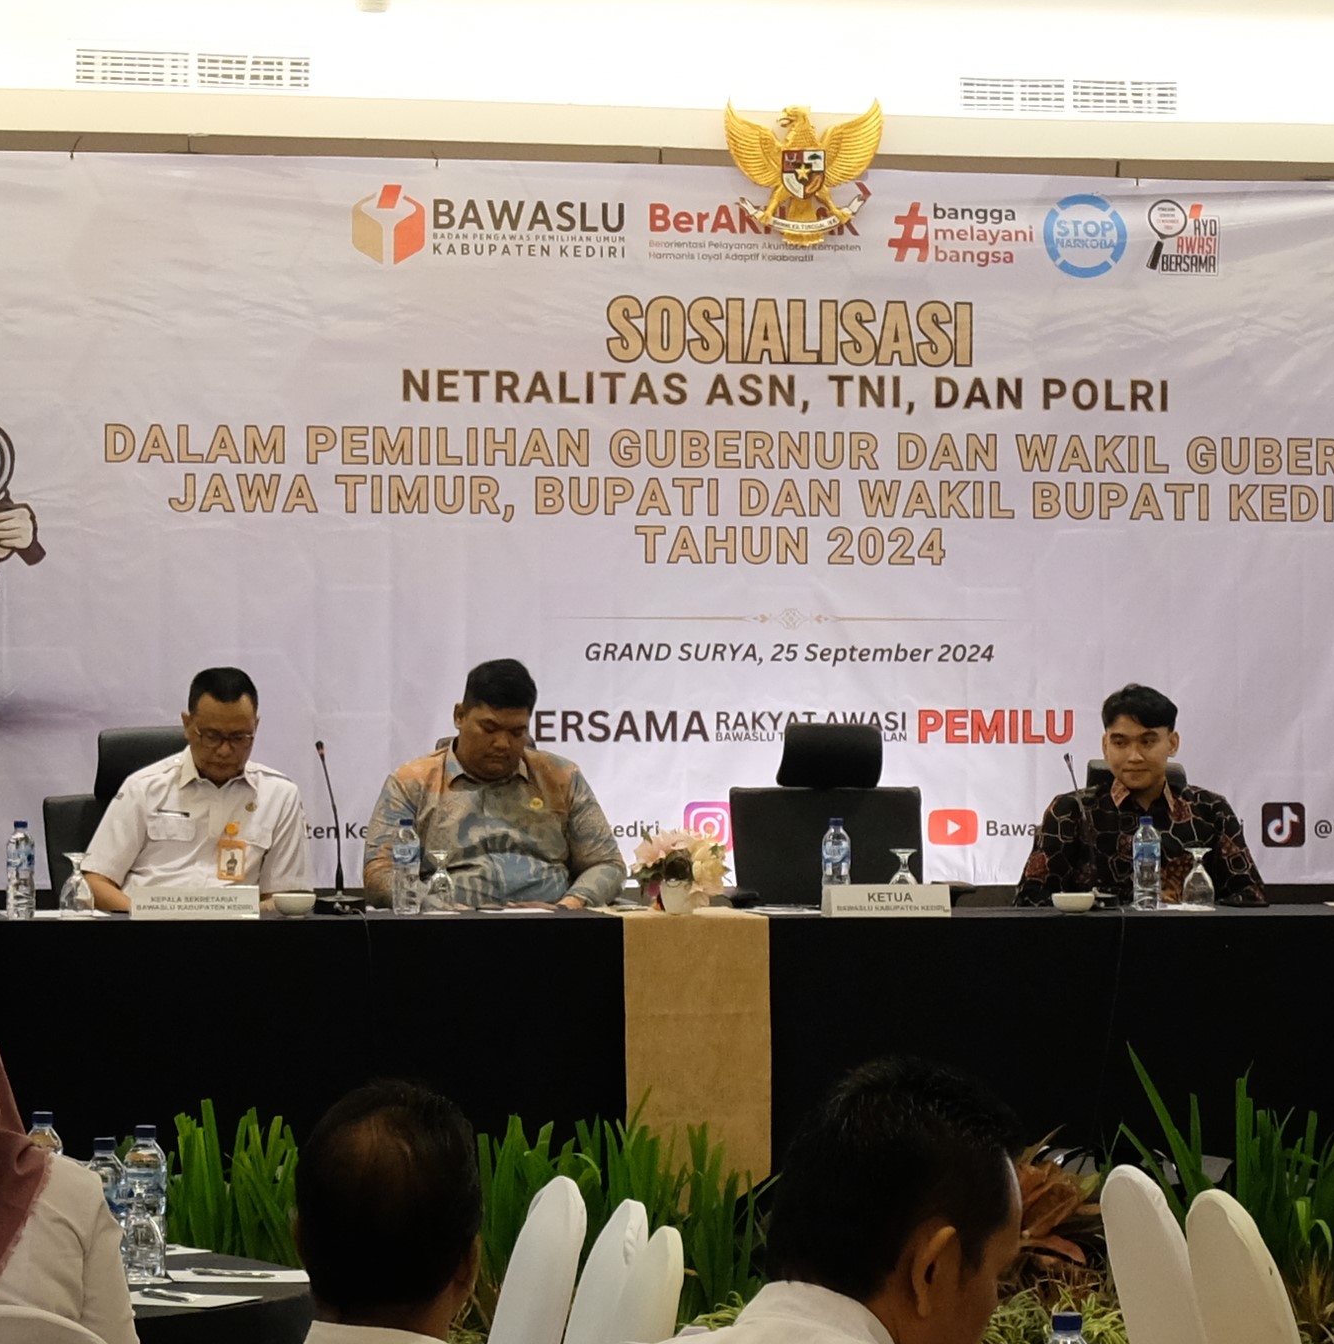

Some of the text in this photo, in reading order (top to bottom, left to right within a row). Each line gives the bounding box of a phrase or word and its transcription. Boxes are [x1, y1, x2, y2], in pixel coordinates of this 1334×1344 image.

[432, 198, 625, 233] BAWASLU
[933, 203, 1016, 224] bangga
[934, 225, 1034, 245] melayani
[1056, 220, 1114, 238] STOP
[1193, 218, 1217, 236] AYO
[432, 232, 625, 243] BADAN PENGAWAS PEMILIHAN UMUM
[708, 240, 759, 251] Pelayanan
[1055, 238, 1116, 250] NARKOBA
[1177, 236, 1216, 254] AWASI
[432, 243, 625, 259] KABUPATEN KEDIRI
[934, 246, 1014, 267] bangsa
[1161, 254, 1216, 273] BERSAMA
[605, 295, 973, 367] SOSIALISASI
[402, 368, 1168, 416] NETRALITAS ASN, TNI, DAN POLRI
[104, 424, 285, 464] DALAM
[305, 425, 589, 468] PEMILIHAN
[609, 429, 878, 471] GUBERNUR
[897, 432, 998, 472] DAN
[1015, 434, 1169, 474] WAKIL
[168, 473, 317, 514] JAWA
[335, 475, 515, 522] TIMUR,
[534, 476, 718, 517] BUPATI
[739, 478, 841, 518] DAN
[859, 480, 1015, 520] WAKIL
[1032, 481, 1210, 521] BUPATI
[635, 525, 946, 566] TAHUN 2024
[584, 642, 995, 667] GRAND SURYA, 25 September 2024
[533, 709, 1074, 745] ERSAMA RAKYAT AWASI PEMILU
[716, 732, 775, 742] BAWASLU
[613, 821, 659, 838] ediri
[986, 820, 1037, 836] Bawa
[867, 892, 913, 902] KETUA
